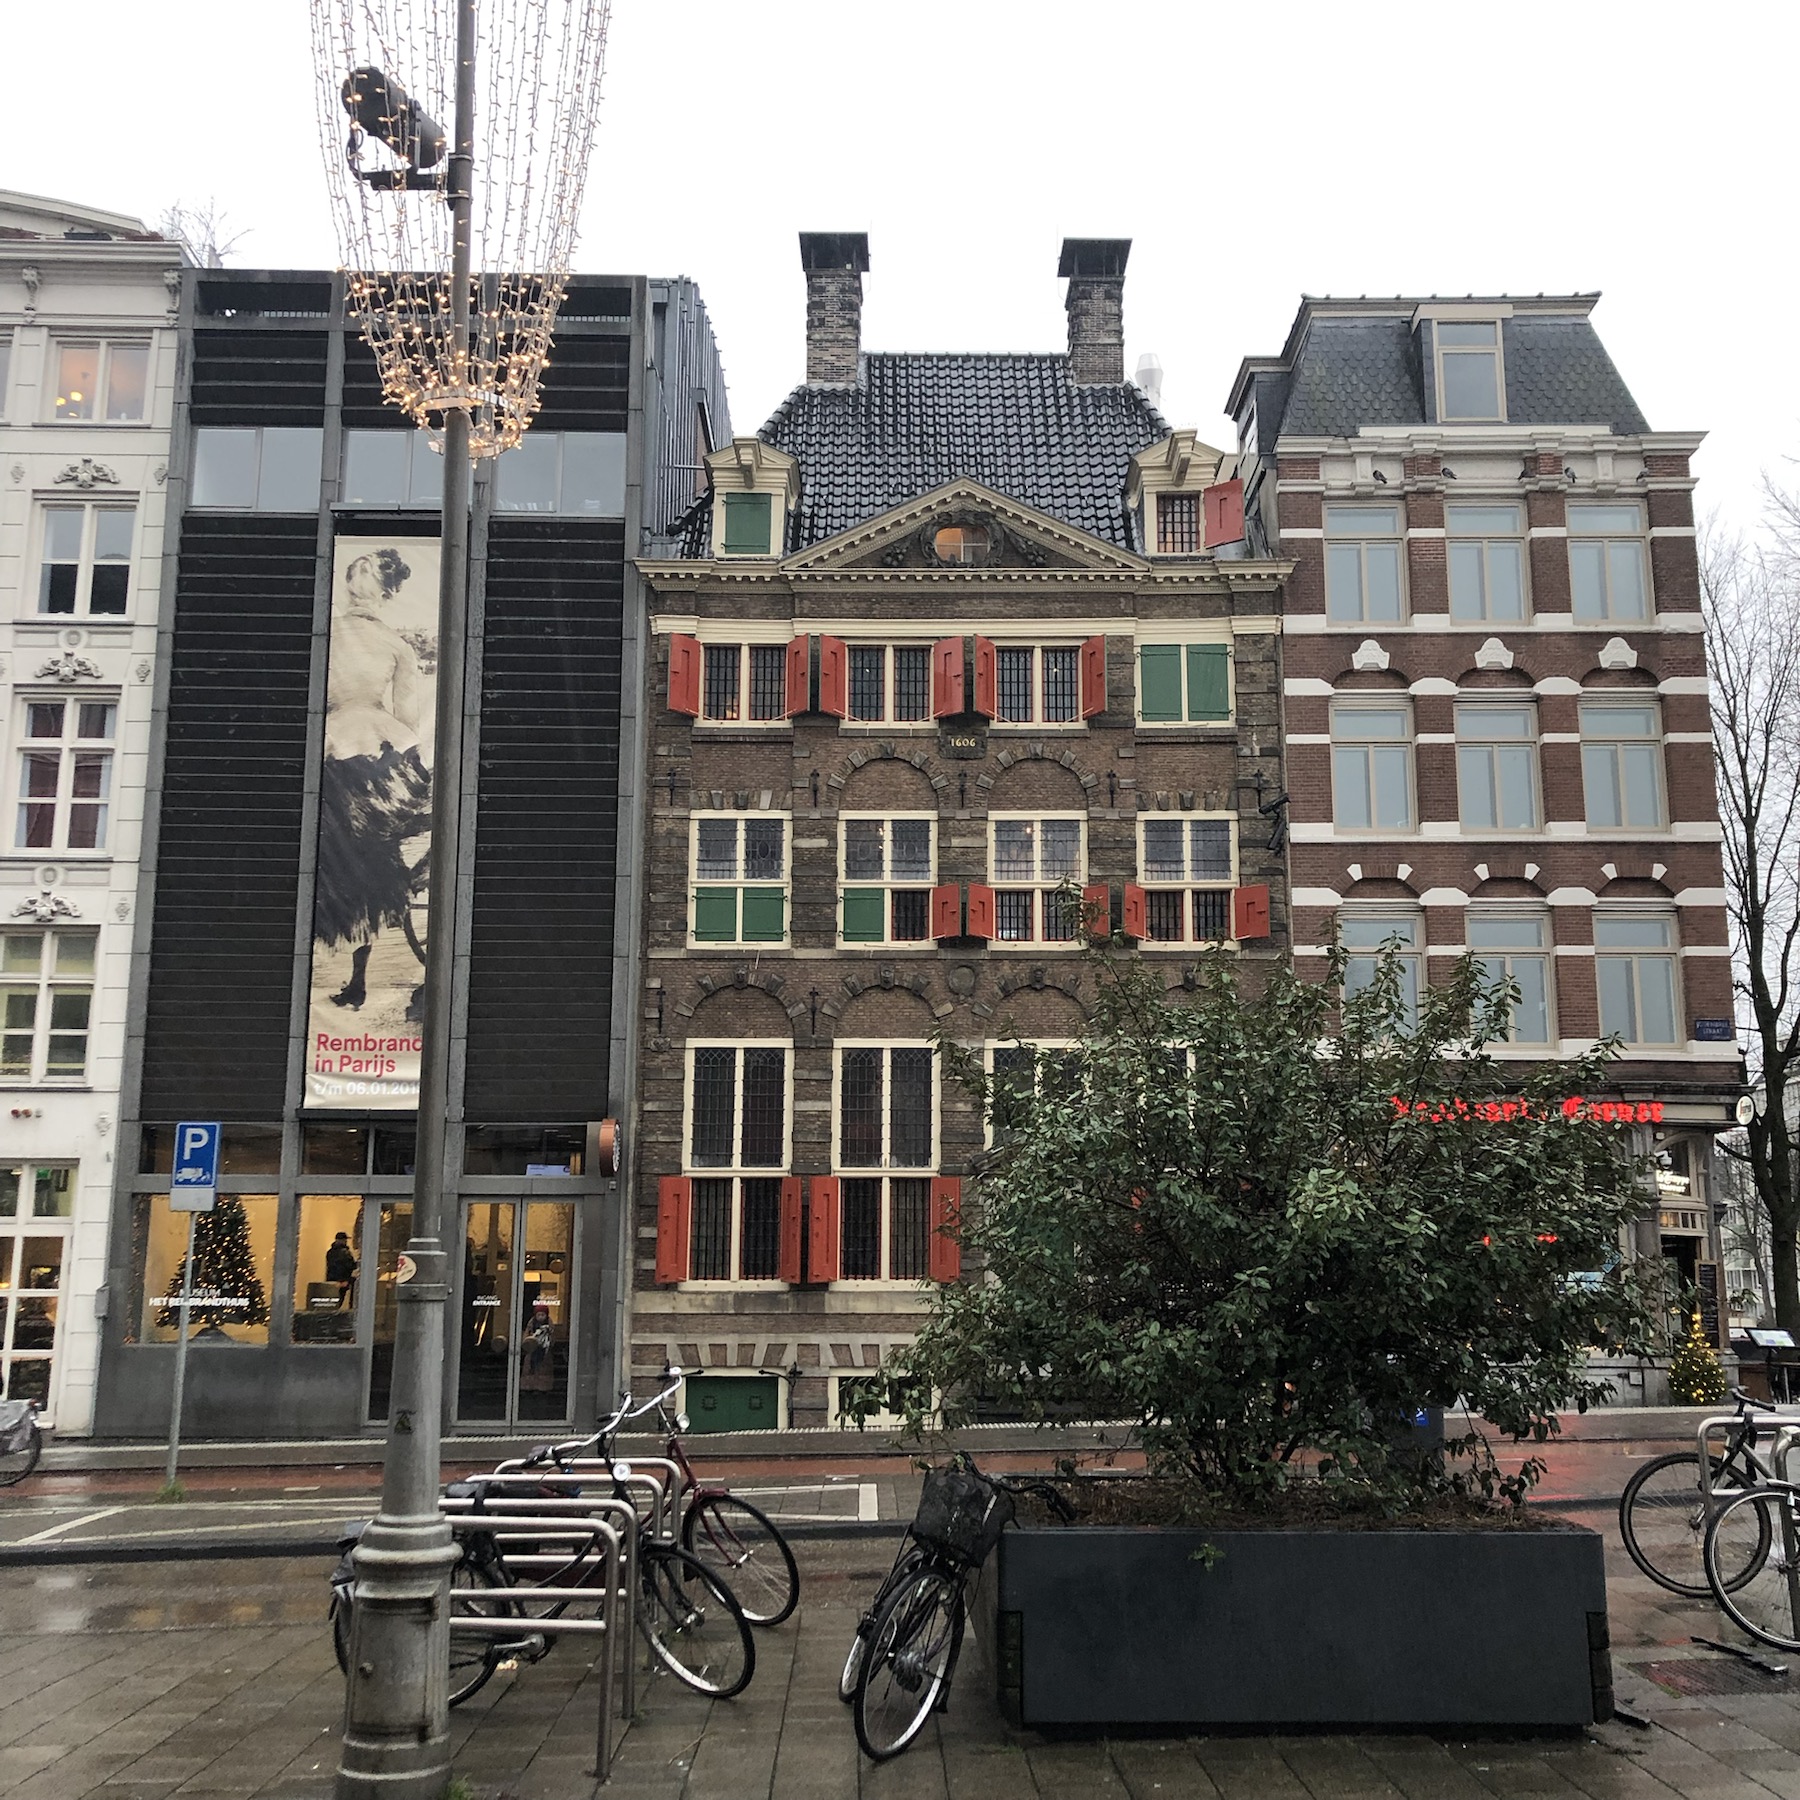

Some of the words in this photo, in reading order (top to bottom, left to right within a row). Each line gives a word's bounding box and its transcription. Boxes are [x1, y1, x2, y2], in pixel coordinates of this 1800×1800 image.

[951, 738, 976, 747] 1606
[315, 1054, 333, 1073] in
[339, 1054, 396, 1078] Parijs
[314, 1082, 343, 1096] t/m
[346, 1081, 420, 1096] 06.01.201
[183, 1127, 210, 1161] P
[148, 1297, 167, 1307] HET
